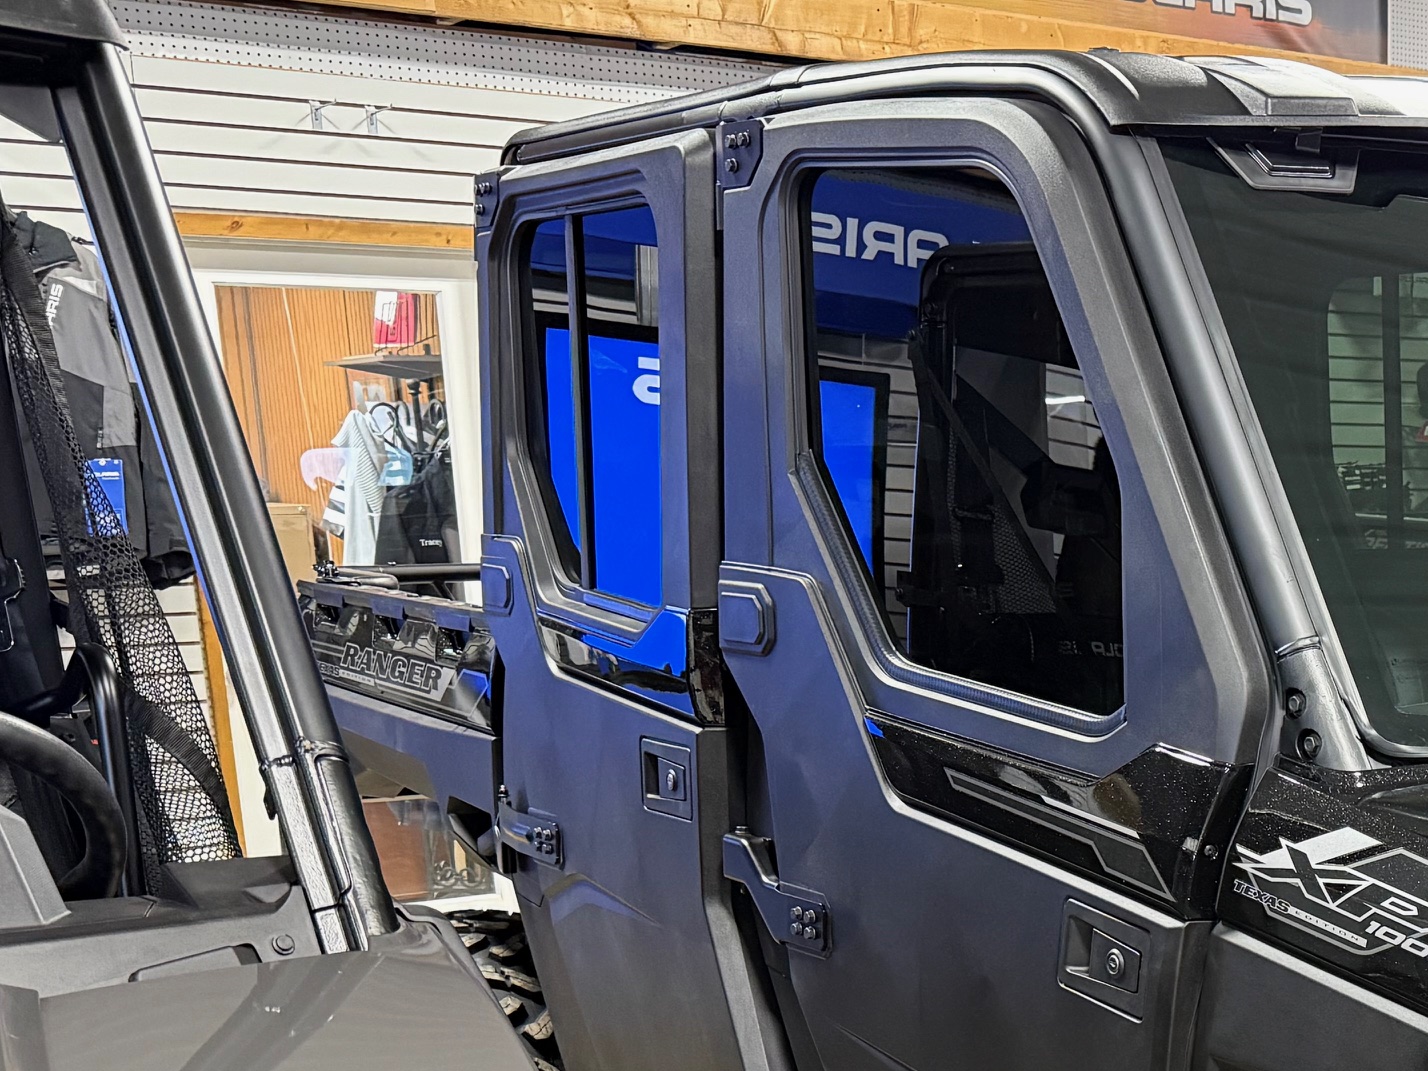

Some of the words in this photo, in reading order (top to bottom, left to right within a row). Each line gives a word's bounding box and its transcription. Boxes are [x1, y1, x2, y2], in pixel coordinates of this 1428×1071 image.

[340, 643, 443, 692] RANGER
[1233, 879, 1291, 914] TEXAS
[1294, 910, 1360, 942] EDITION
